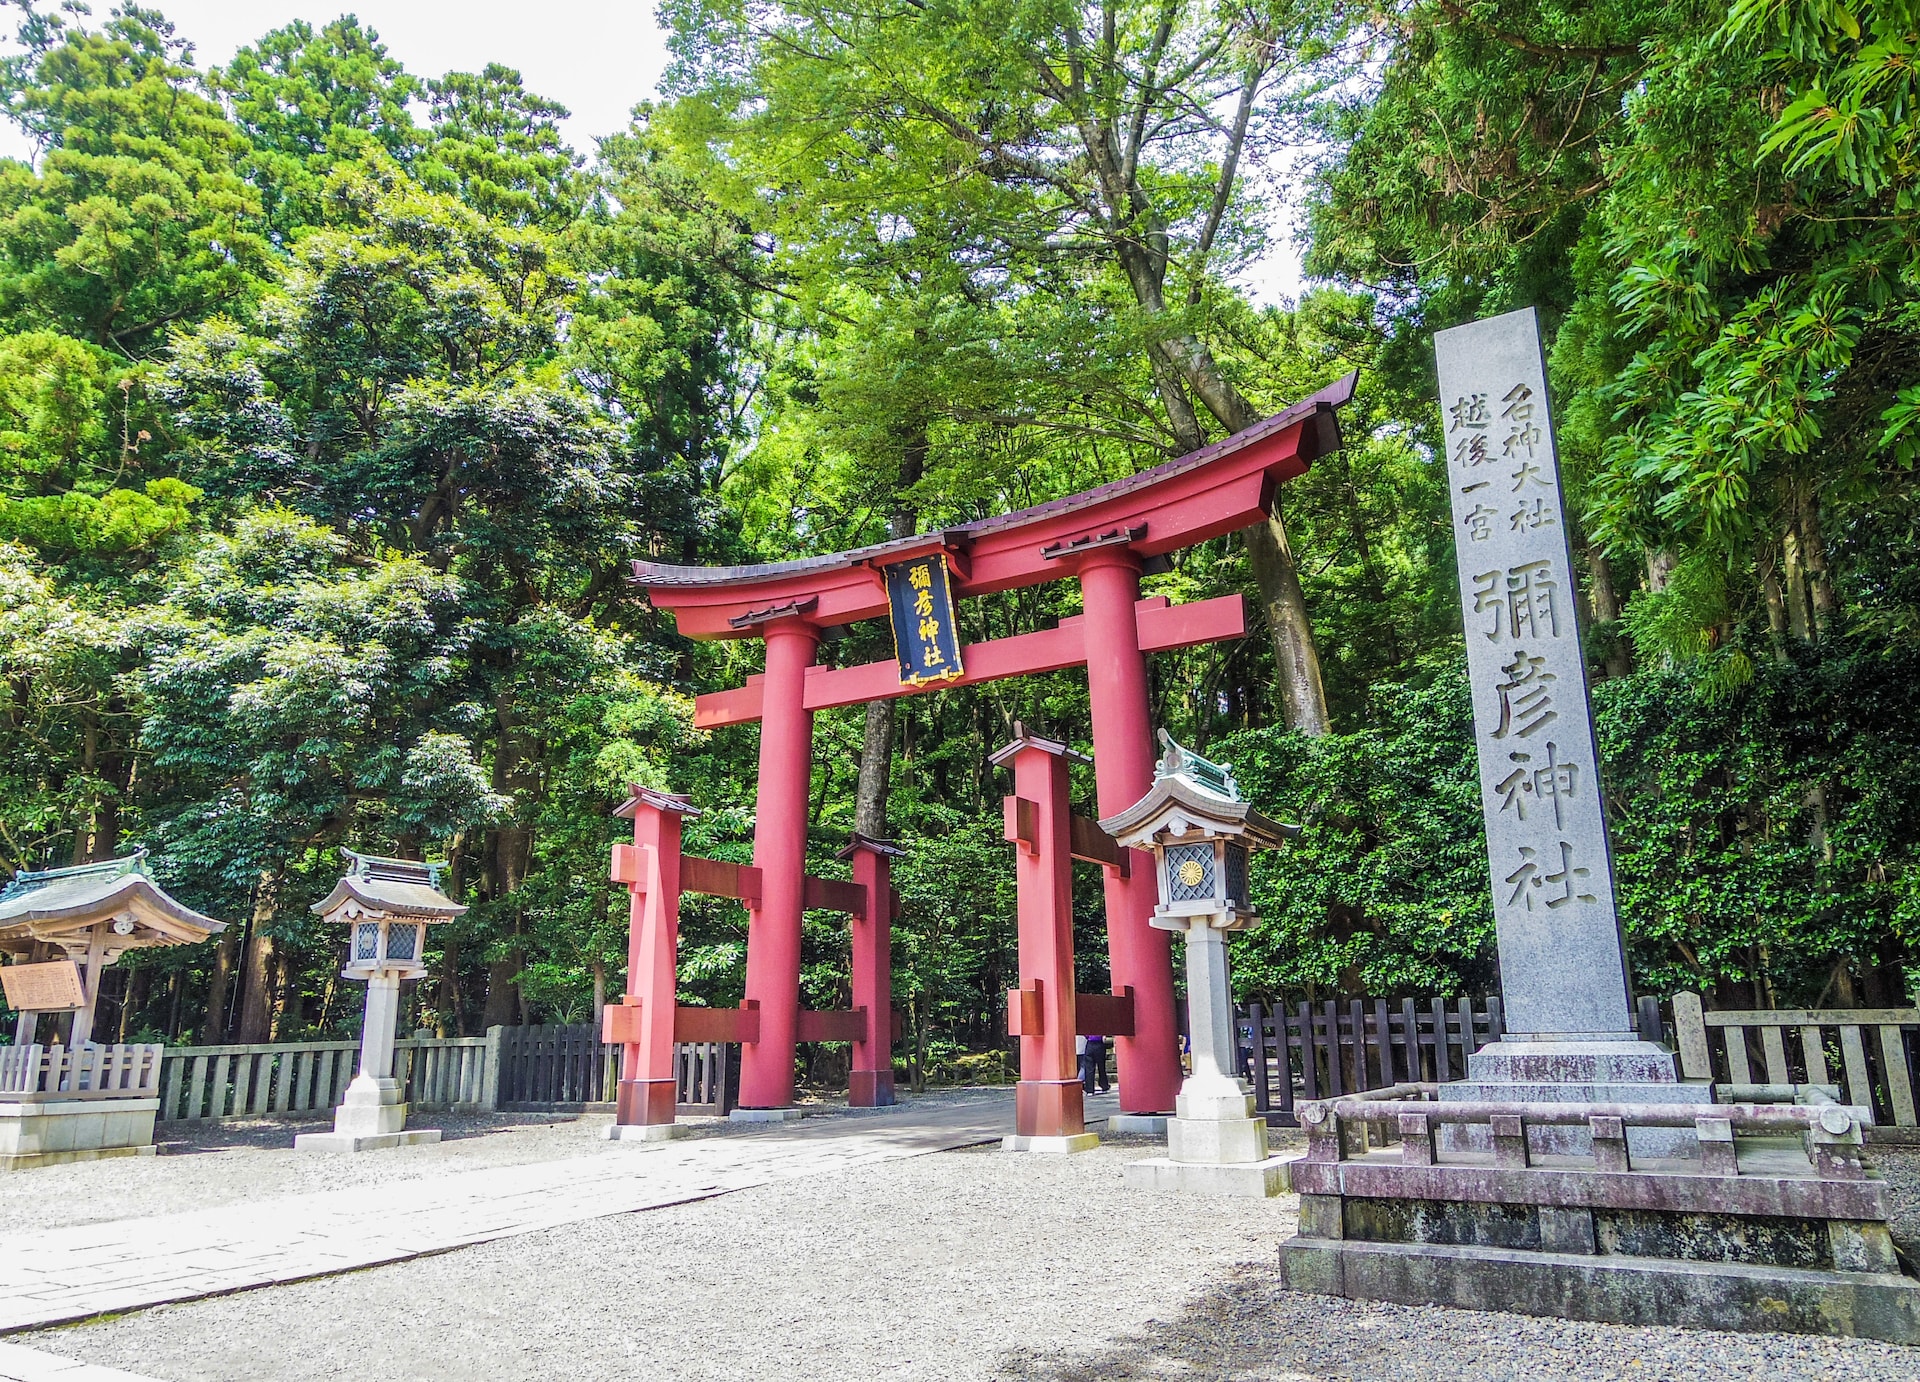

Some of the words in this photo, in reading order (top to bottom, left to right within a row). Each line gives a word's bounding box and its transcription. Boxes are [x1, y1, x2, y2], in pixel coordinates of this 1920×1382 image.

[1450, 393, 1497, 541] 越後一宮
[1501, 383, 1555, 533] 名神大社
